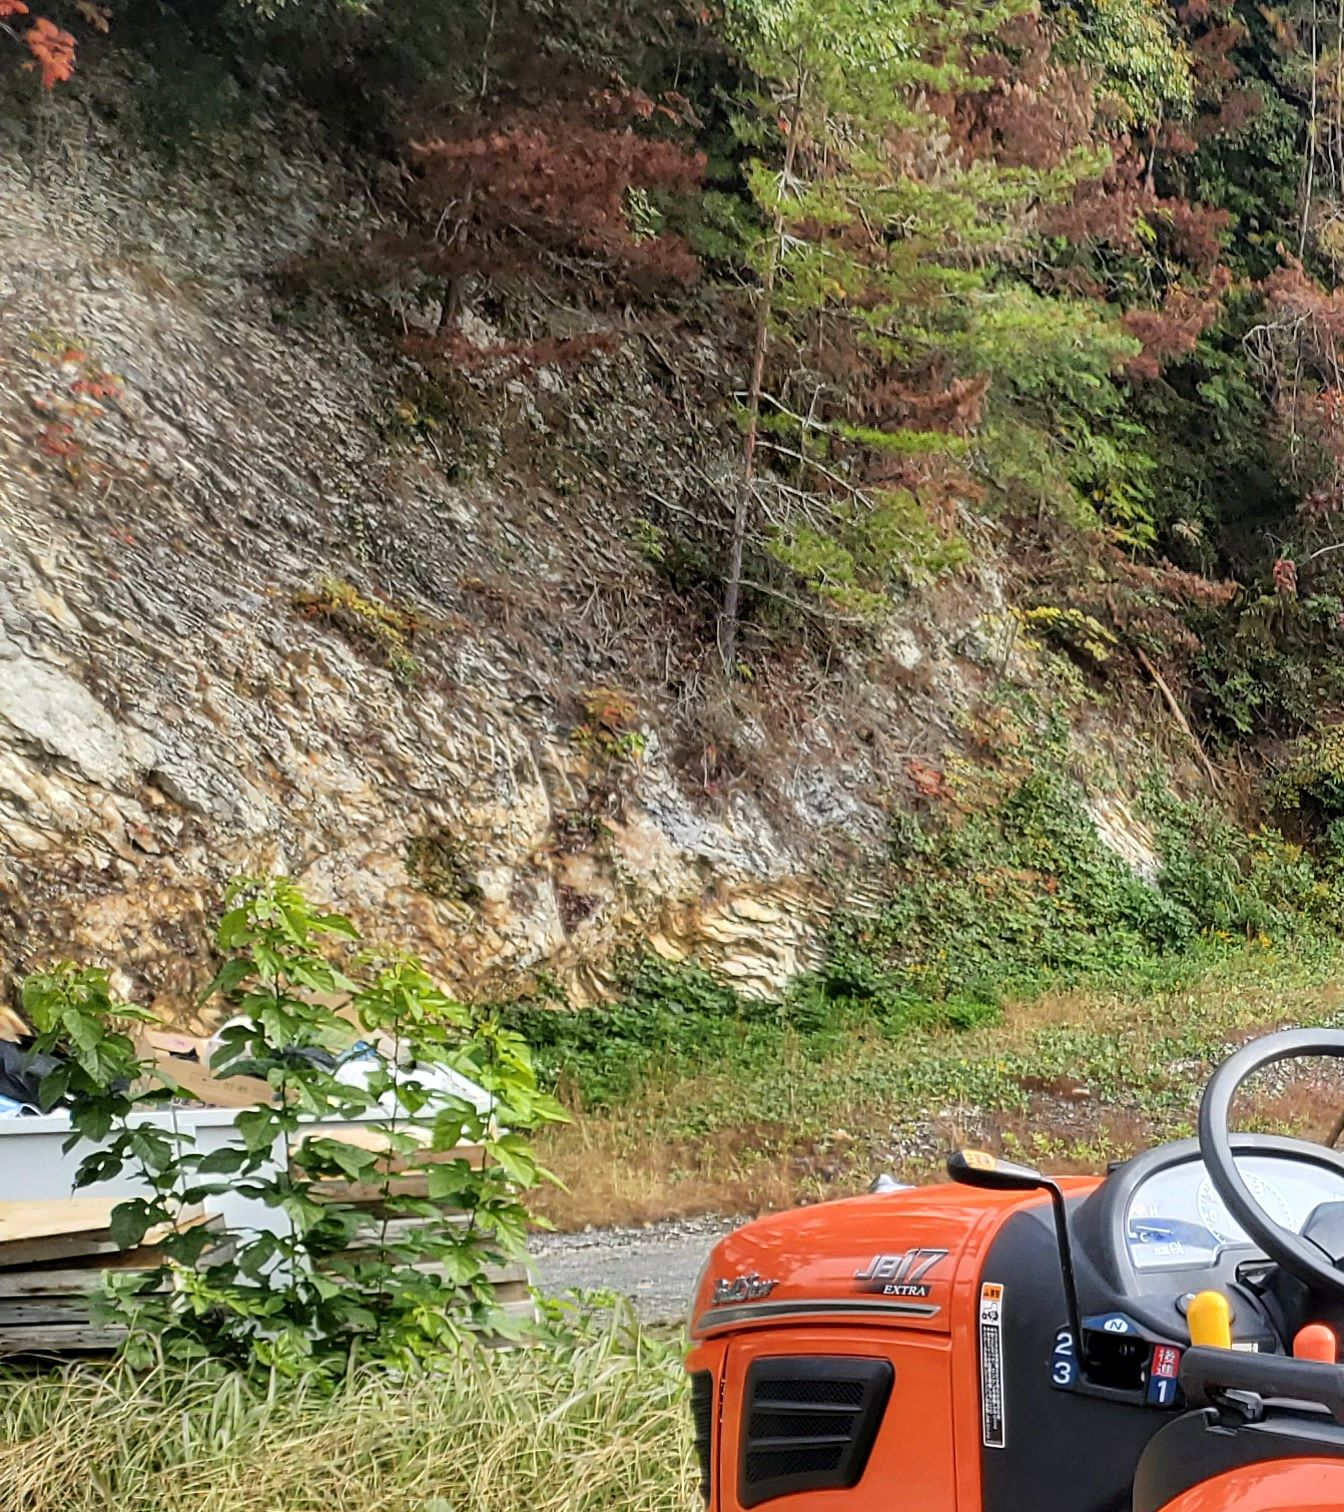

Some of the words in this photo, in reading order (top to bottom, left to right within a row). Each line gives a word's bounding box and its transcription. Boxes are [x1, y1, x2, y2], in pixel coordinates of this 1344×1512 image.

[853, 1248, 950, 1283] JB17
[883, 1284, 926, 1297] EXTRA
[1109, 1321, 1123, 1330] N
[1054, 1332, 1073, 1356] 2
[1052, 1361, 1071, 1384] 3
[1157, 1380, 1168, 1403] 1
